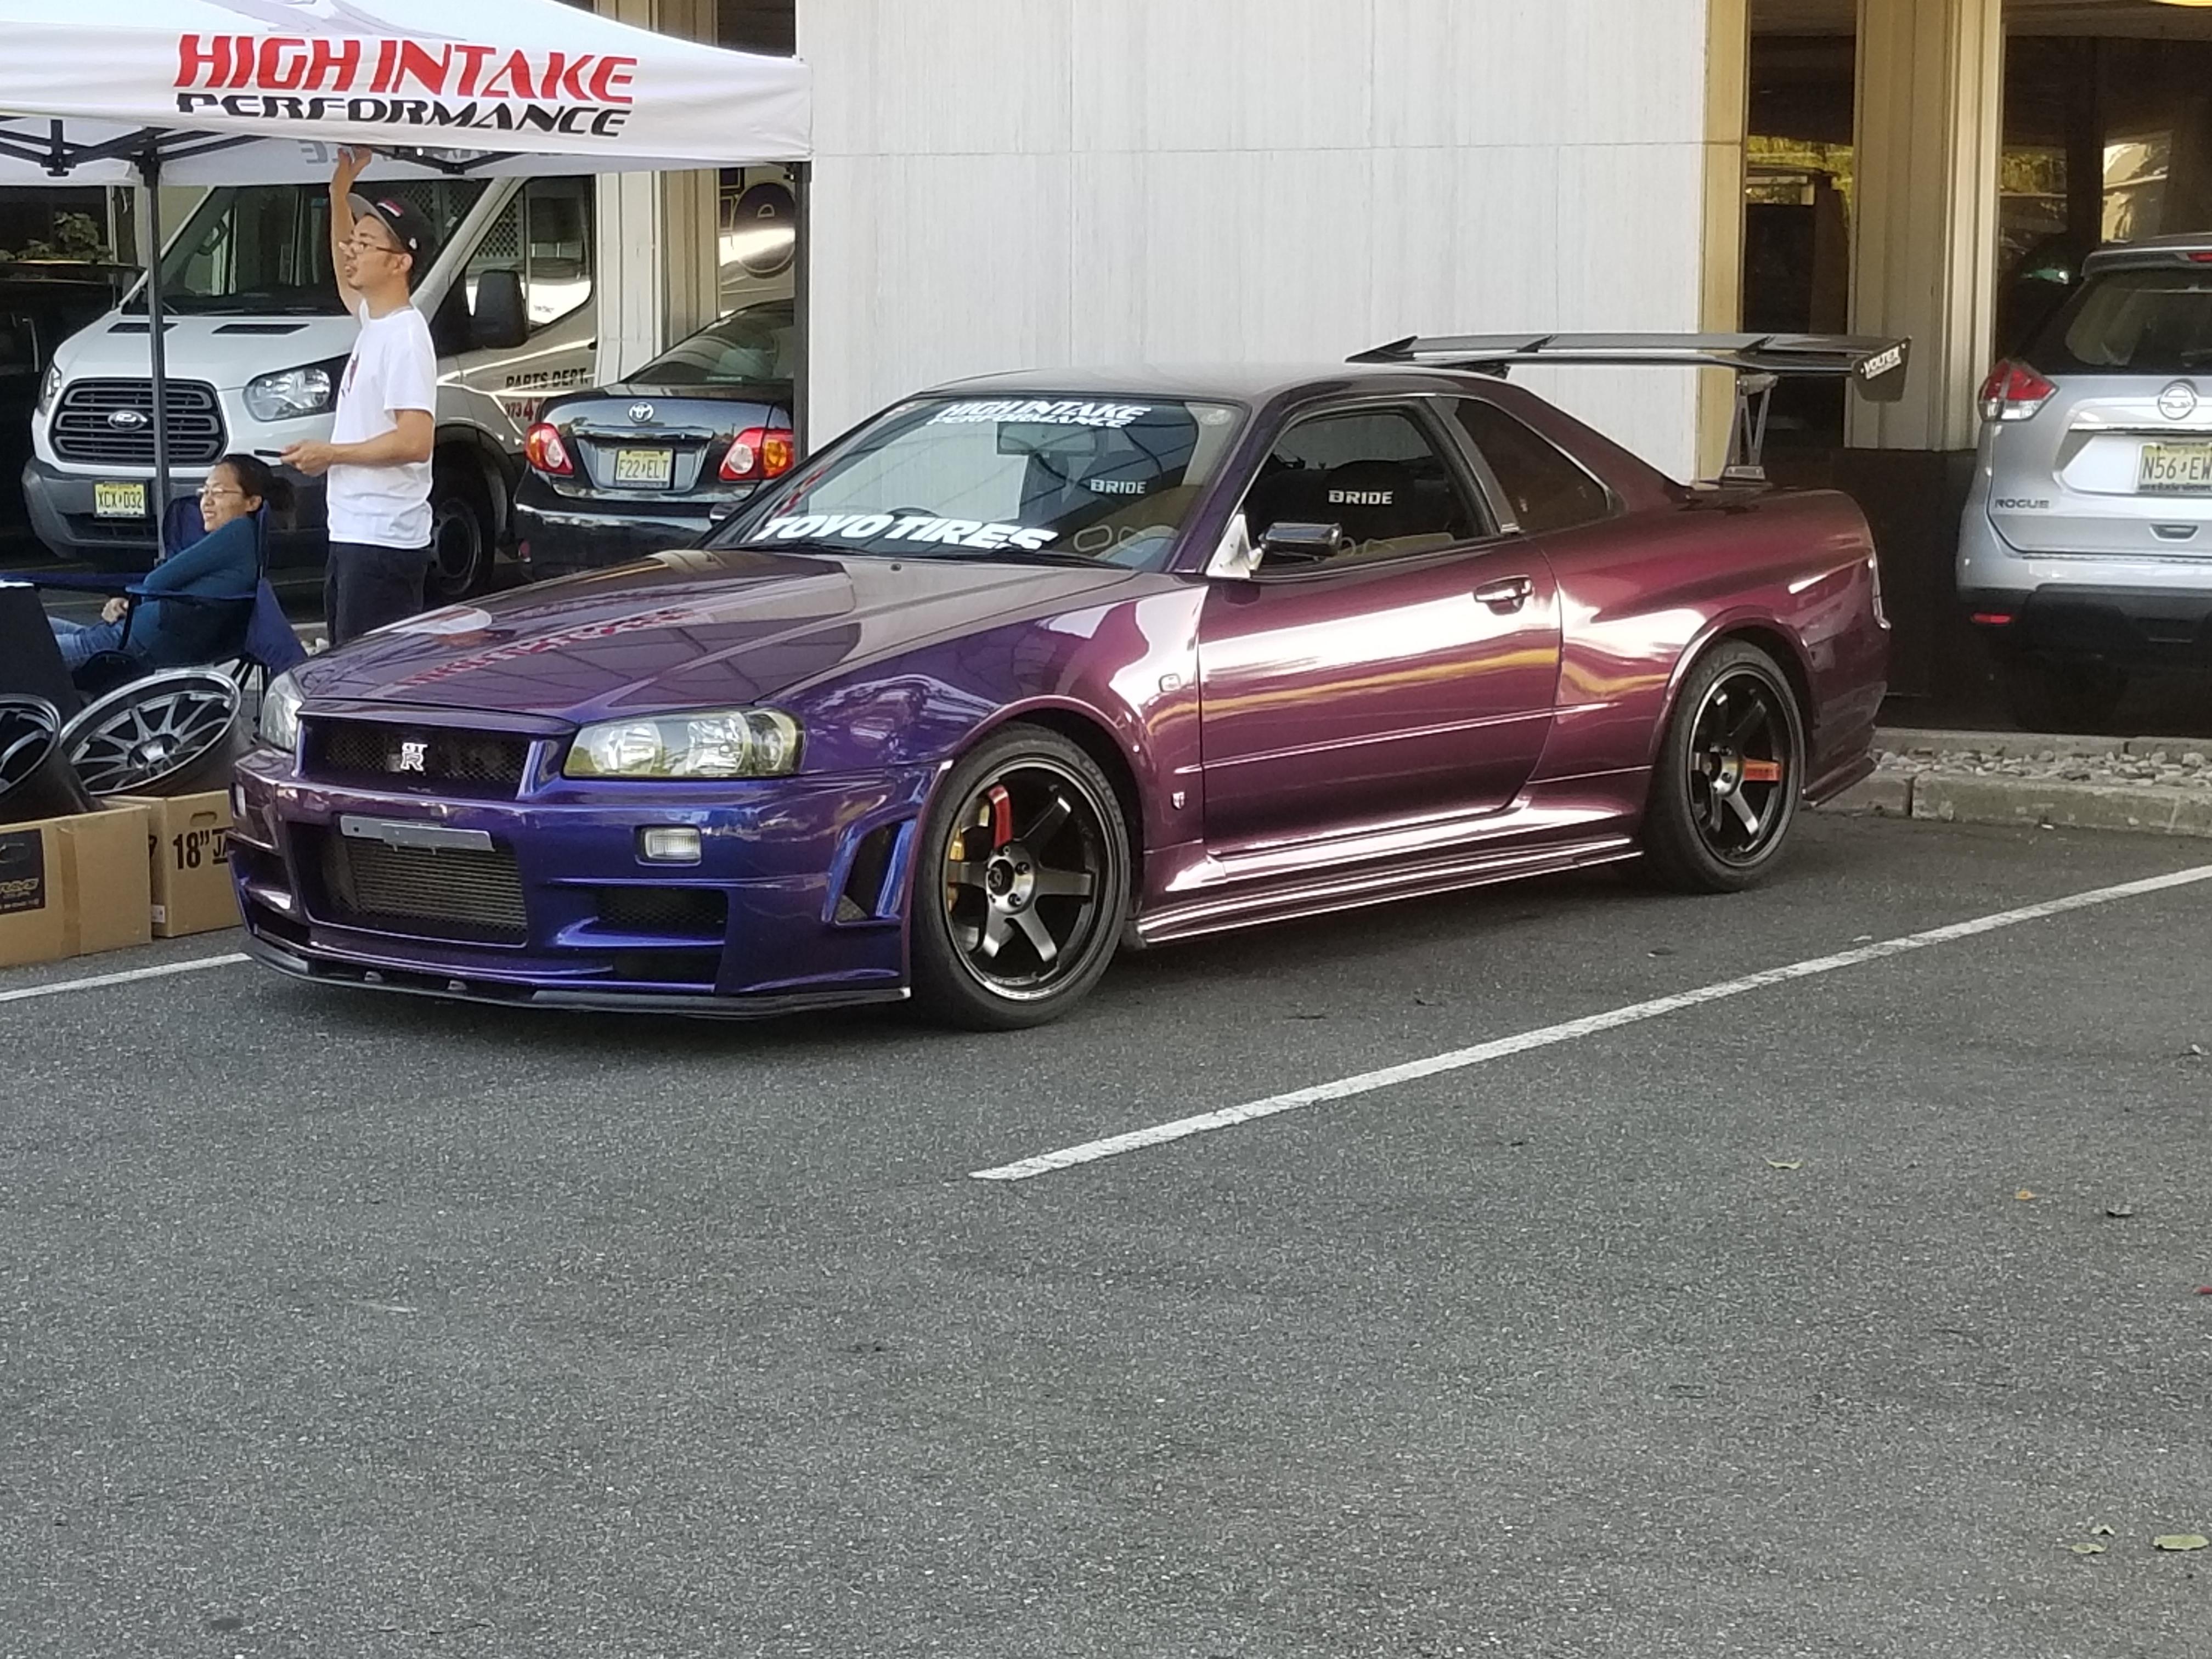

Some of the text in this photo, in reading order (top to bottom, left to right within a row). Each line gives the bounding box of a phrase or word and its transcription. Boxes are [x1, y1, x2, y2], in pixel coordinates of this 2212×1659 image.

[173, 33, 638, 105] HIGH INTAKE
[176, 93, 631, 137] PERFORMANCE
[505, 372, 548, 389] PARTS
[618, 459, 669, 479] F22 ELT
[2142, 456, 2176, 479] N56
[1090, 479, 1147, 494] BRIDE
[1328, 489, 1393, 504] BRIDE
[1995, 499, 2049, 509] ROGUE
[751, 515, 1059, 550] TOYO TIRES
